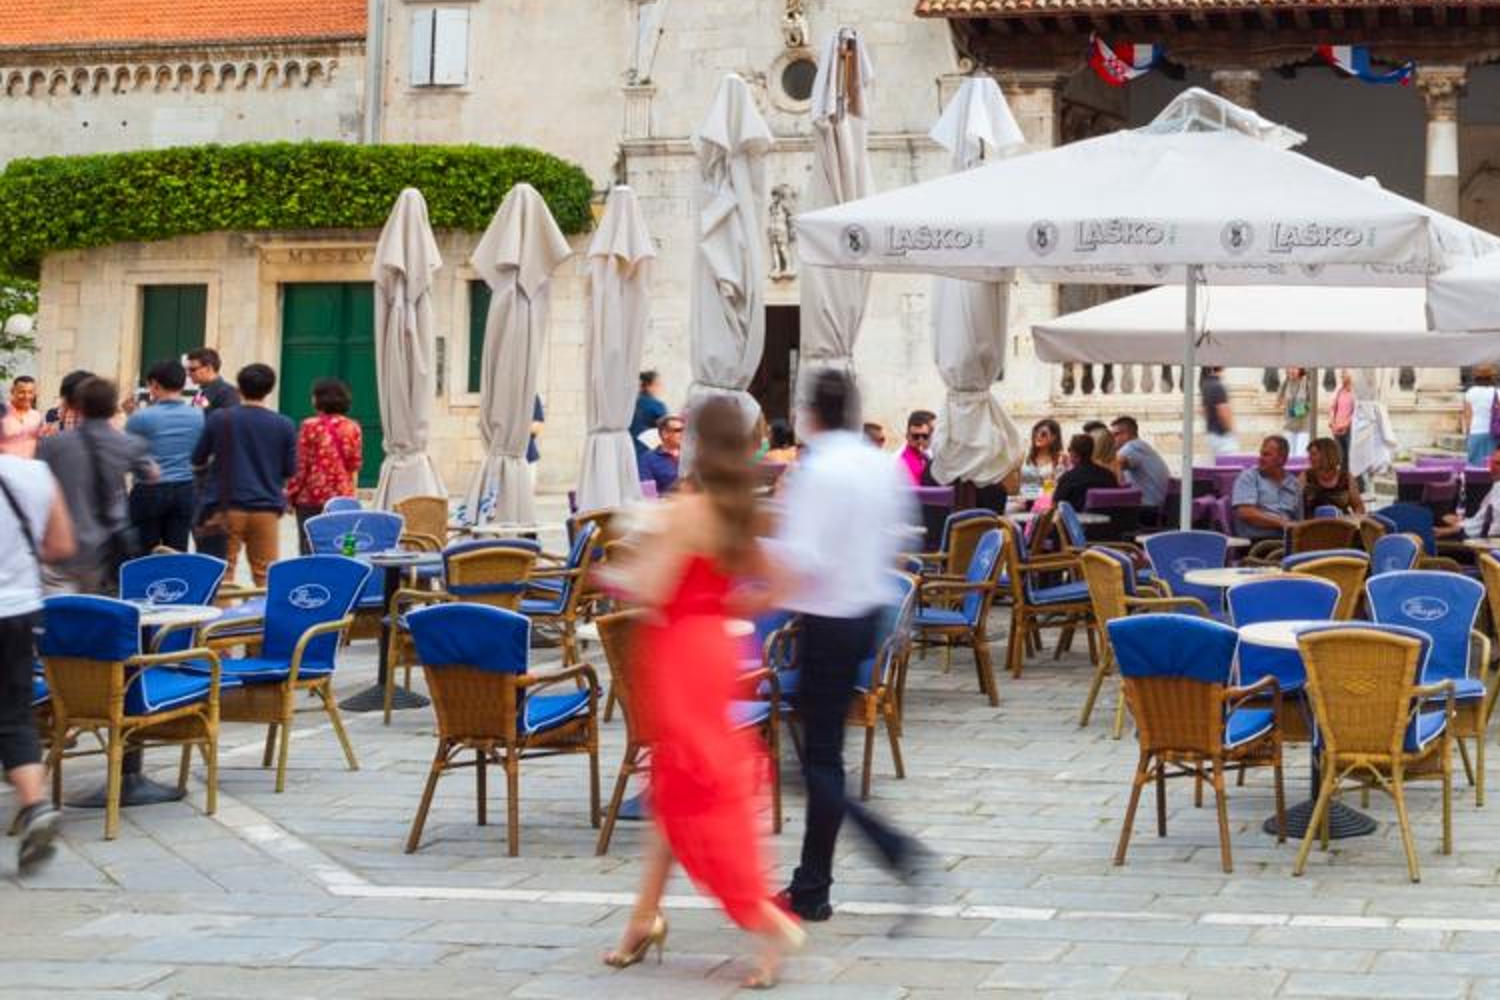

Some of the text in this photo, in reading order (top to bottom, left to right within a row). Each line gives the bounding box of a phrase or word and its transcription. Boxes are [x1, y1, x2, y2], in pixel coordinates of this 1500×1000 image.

[882, 224, 973, 256] LAŠKO
[1073, 218, 1165, 252] LAŠKO
[1267, 221, 1363, 254] LAŠKO
